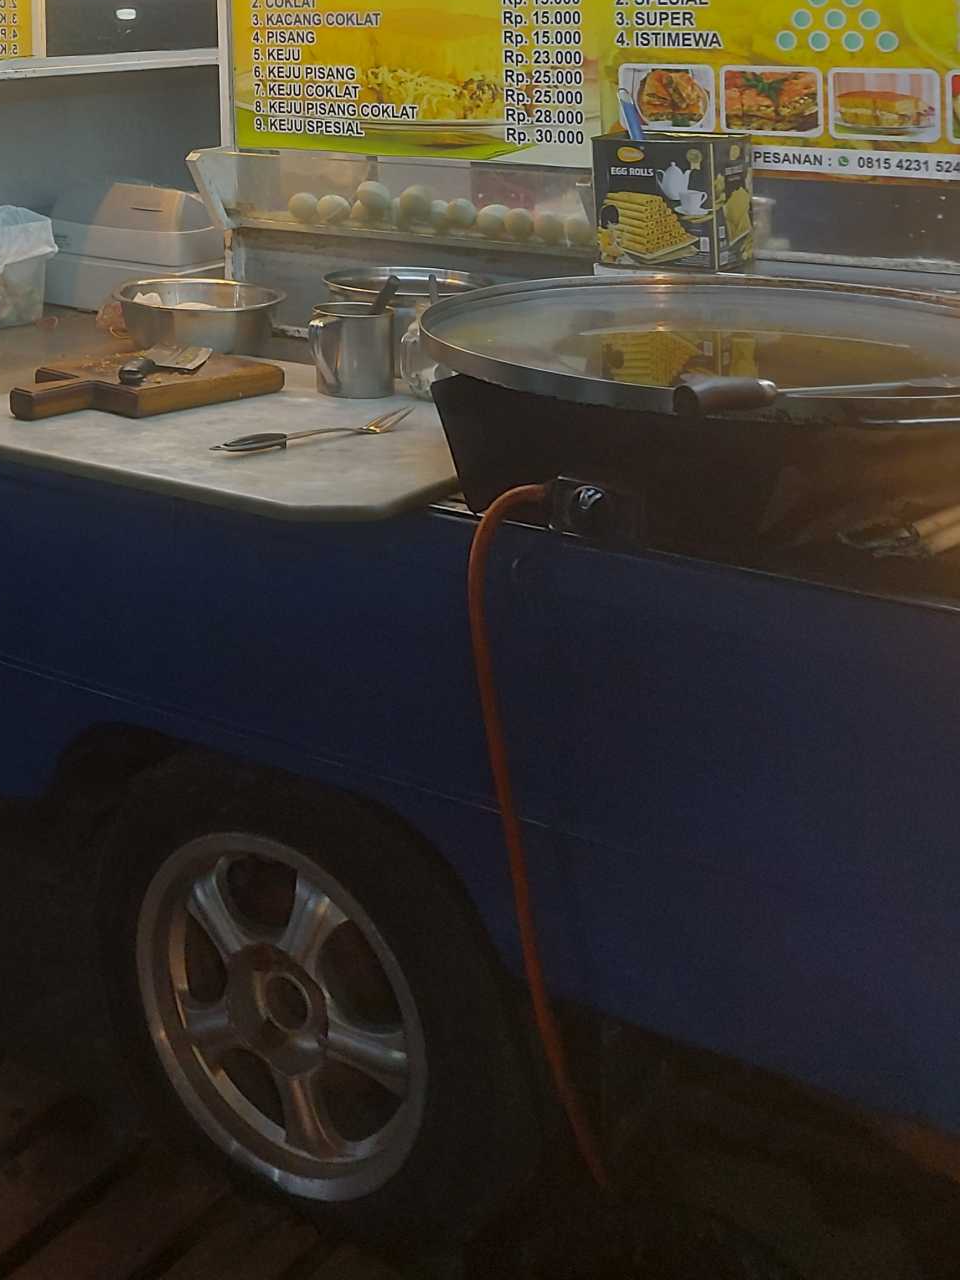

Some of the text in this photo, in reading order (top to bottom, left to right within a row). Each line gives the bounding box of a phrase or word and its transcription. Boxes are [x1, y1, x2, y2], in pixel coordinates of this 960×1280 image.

[252, 12, 381, 26] 3. KACANG COKLAT
[503, 11, 581, 27] Rp. 15.000
[616, 11, 695, 26] 3. SUPER
[253, 30, 316, 44] 4. PISANG
[503, 30, 582, 47] Rp. 15.000
[616, 32, 723, 48] 4. ISTIMEWA
[253, 48, 301, 62] 5. KEJU
[504, 50, 582, 66] Rp. 23.000
[254, 66, 356, 81] 6. KEJU PISANG
[504, 69, 583, 86] Rp. 25.000
[254, 83, 360, 99] 7. KEJU COKLAT
[505, 89, 583, 105] Rp. 25.000
[255, 101, 417, 120] 8. KEJU PISANG COKLAT
[506, 108, 584, 125] Rp. 28.000
[255, 118, 364, 136] 9. KEJU SPESIAL
[506, 128, 584, 145] Rp. 30.000
[753, 151, 823, 167] PESANAN
[857, 157, 892, 170] 0815
[896, 158, 929, 172] 4231
[610, 167, 654, 177] EGG ROLLS
